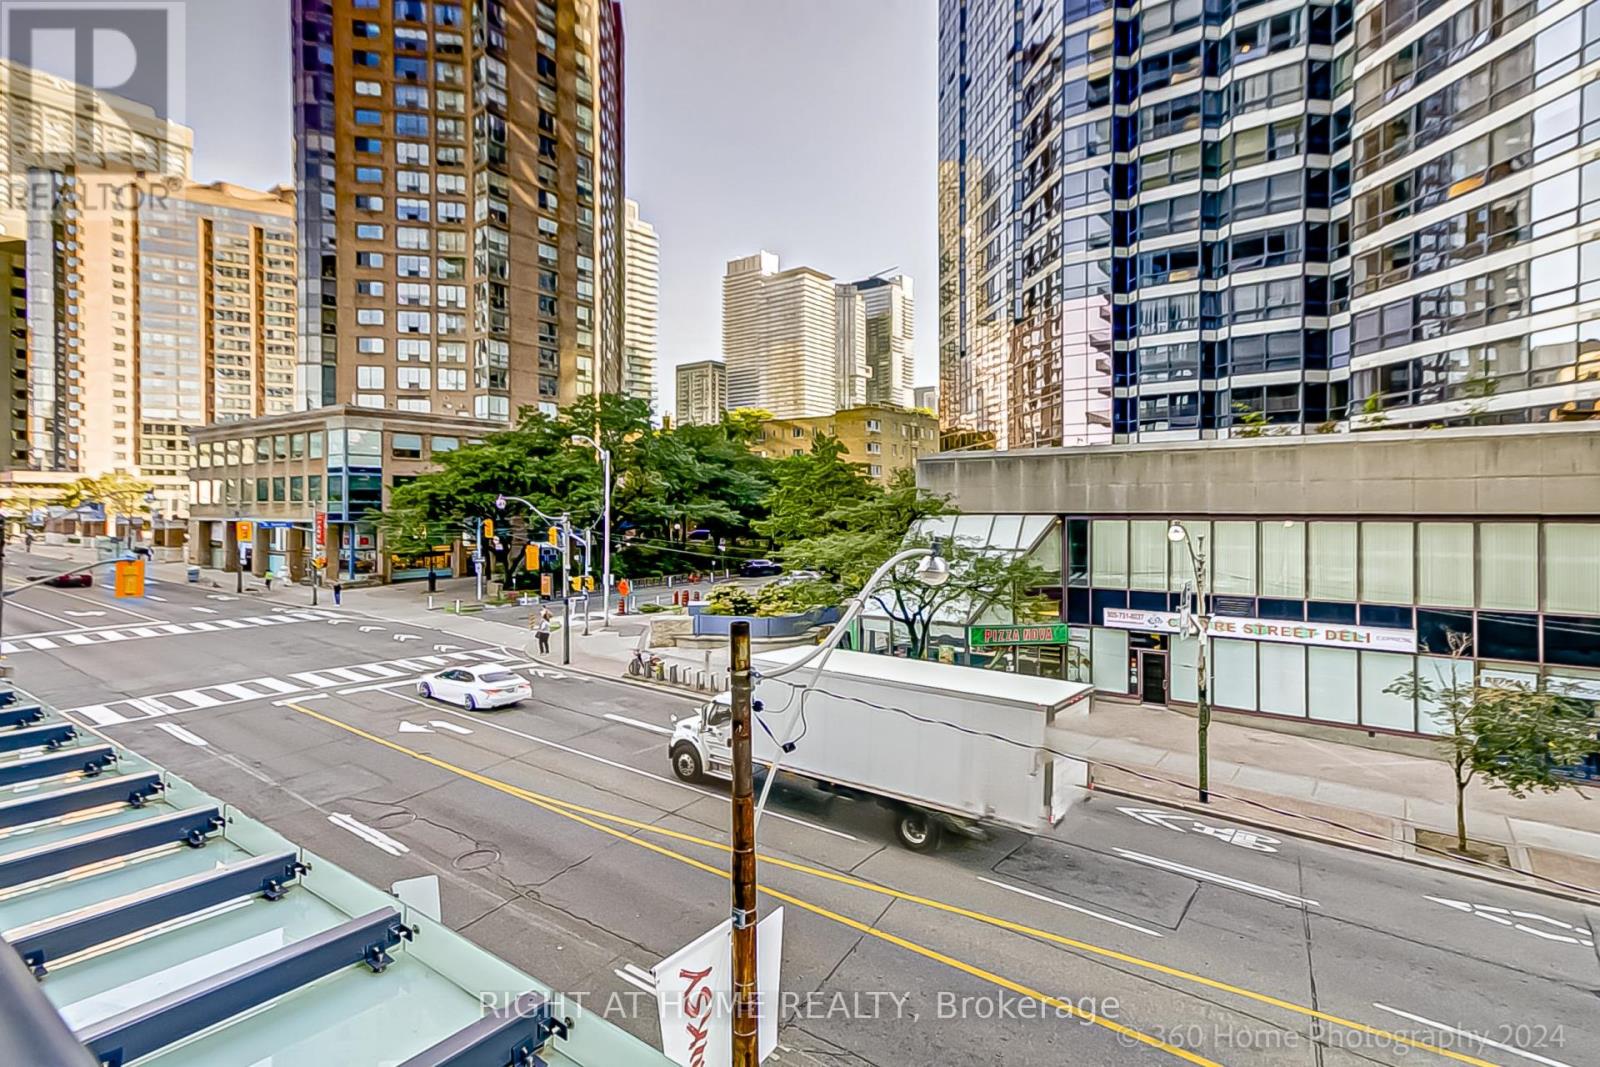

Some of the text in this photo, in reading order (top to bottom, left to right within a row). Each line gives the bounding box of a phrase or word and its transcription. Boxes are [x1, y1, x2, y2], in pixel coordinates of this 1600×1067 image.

[984, 628, 1020, 643] PIZZA
[1023, 627, 1054, 641] NOVA
[1243, 624, 1318, 639] STREET
[1325, 629, 1371, 644] DELI
